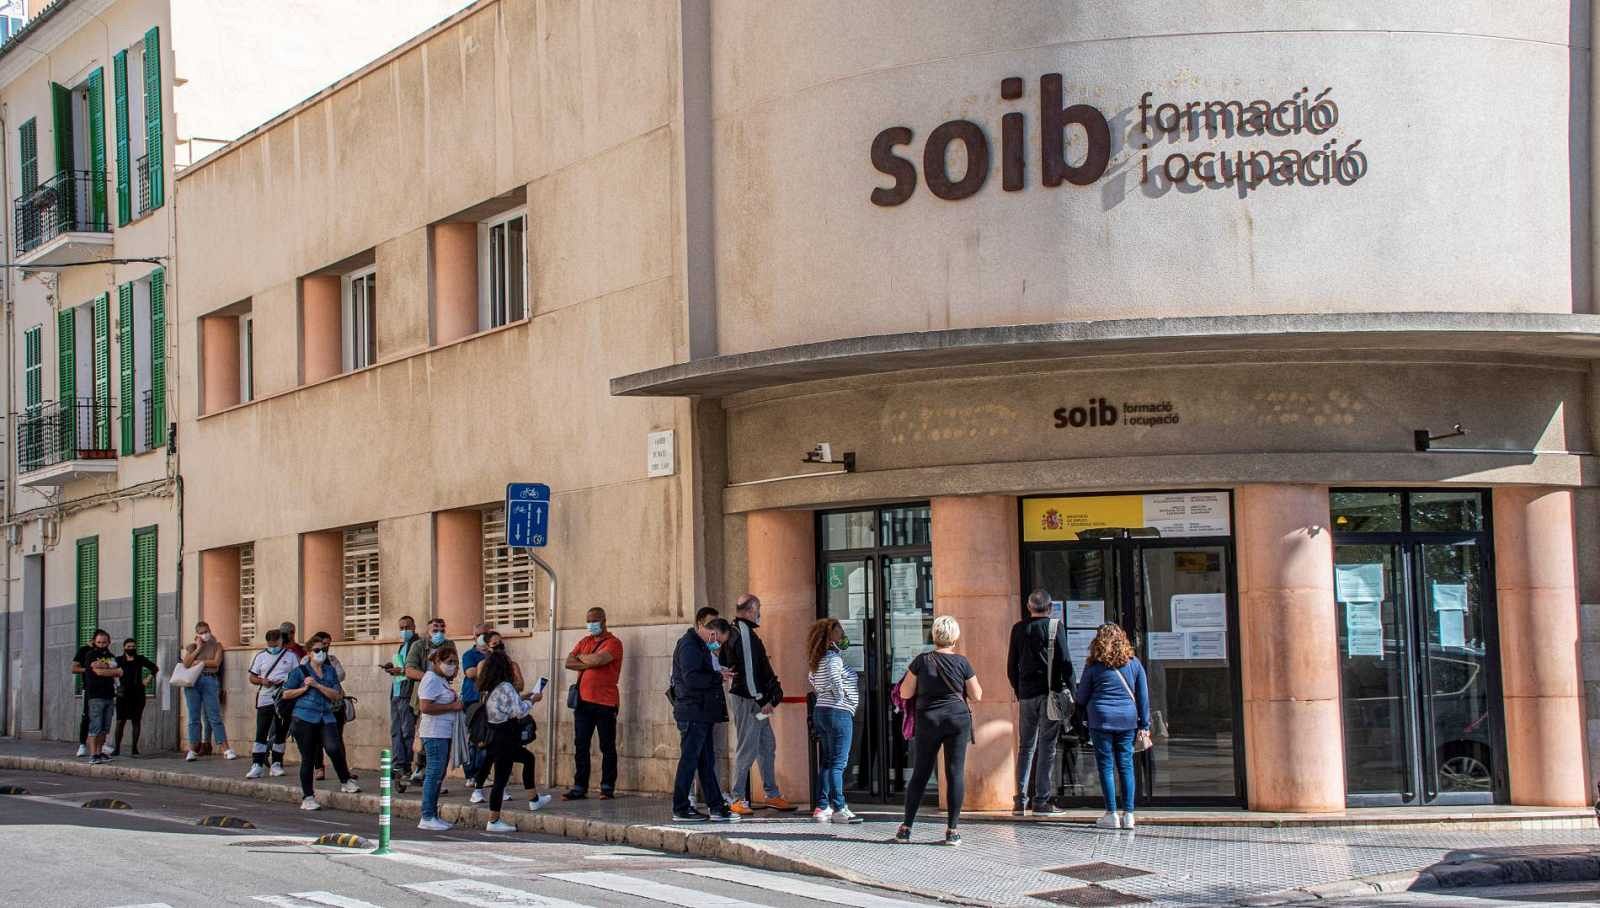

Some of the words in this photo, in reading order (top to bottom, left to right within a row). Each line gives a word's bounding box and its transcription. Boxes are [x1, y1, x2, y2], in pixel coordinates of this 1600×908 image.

[1138, 87, 1339, 133] formació
[870, 72, 1112, 207] soib
[1140, 143, 1149, 184] i
[1163, 139, 1368, 191] ocupació
[1053, 397, 1118, 429] soib
[1122, 401, 1173, 413] formació
[1123, 414, 1128, 426] i
[1129, 412, 1180, 428] ocupació
